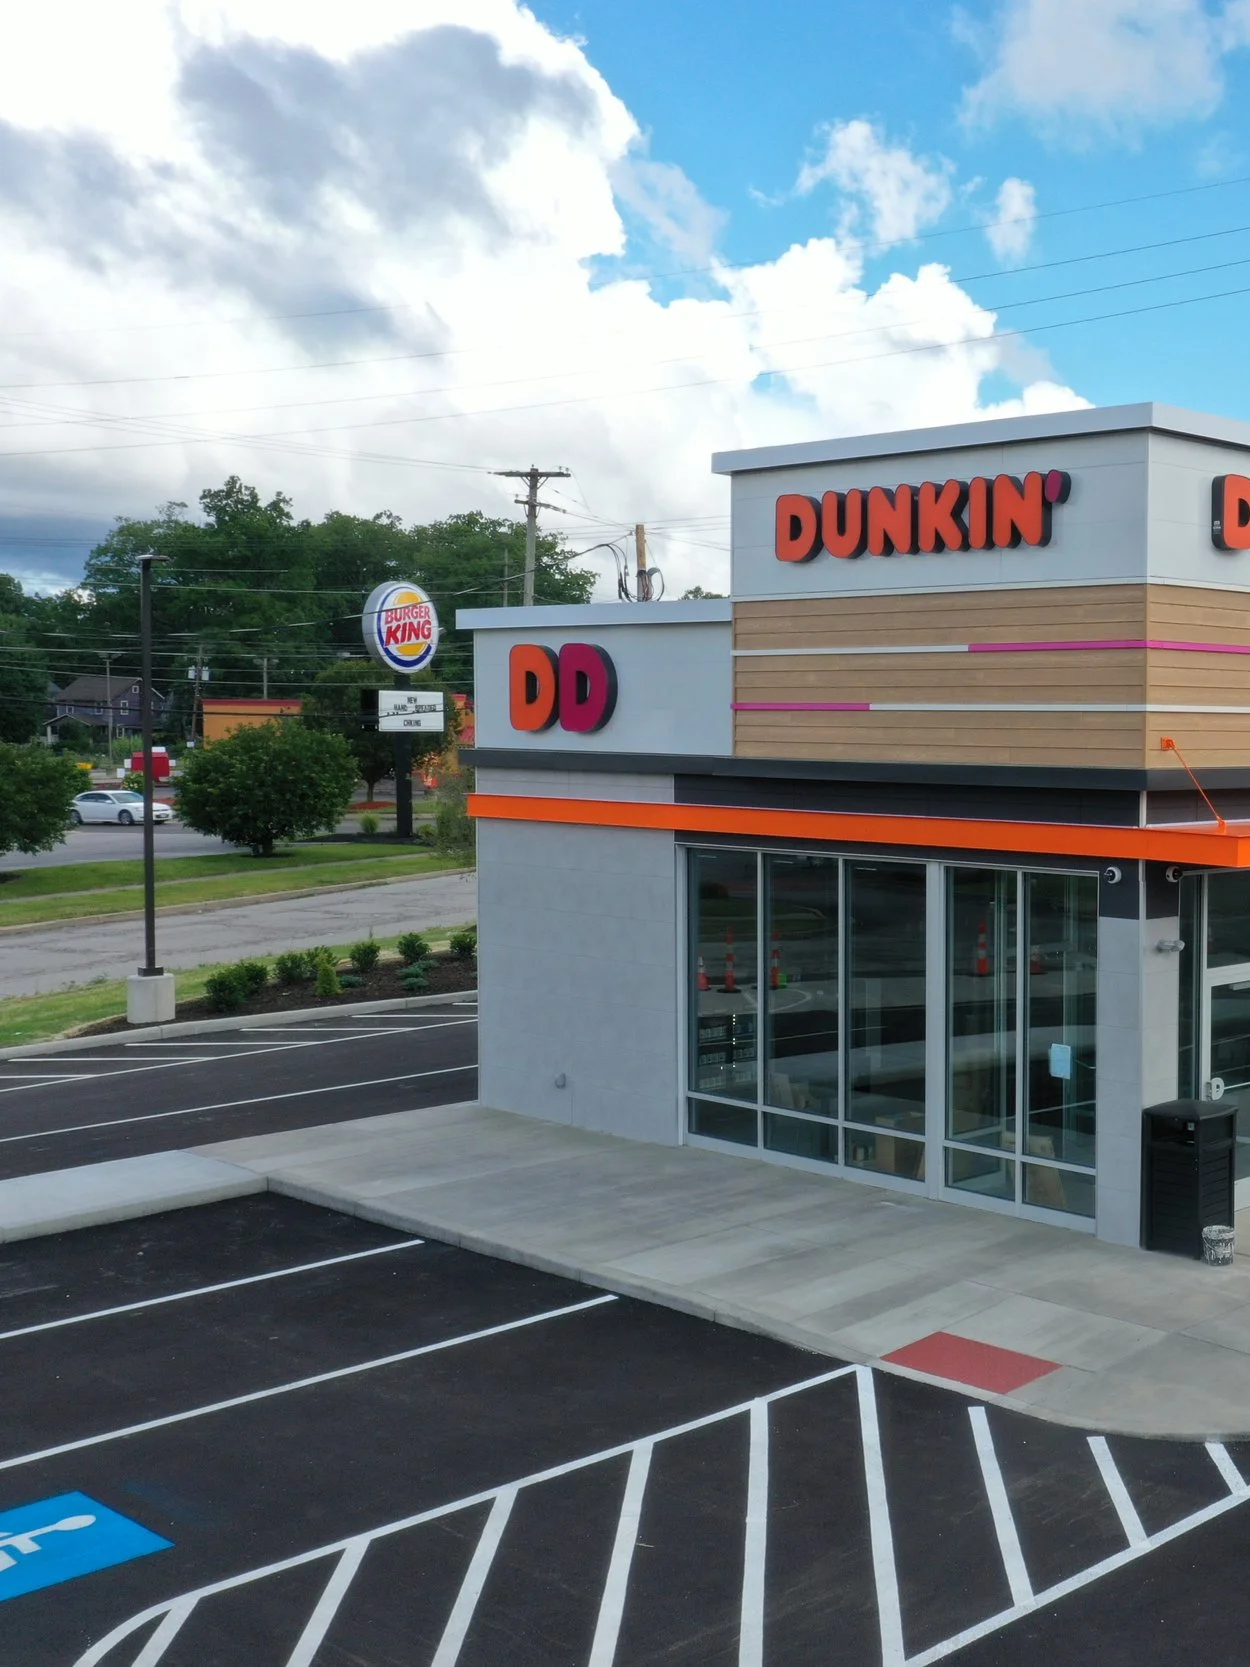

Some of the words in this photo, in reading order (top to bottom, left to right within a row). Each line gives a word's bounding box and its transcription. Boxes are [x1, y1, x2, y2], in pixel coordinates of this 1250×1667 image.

[775, 469, 1071, 562] DUNKIN'
[384, 604, 431, 625] BURGER
[384, 619, 432, 647] KING
[509, 643, 618, 732] DD
